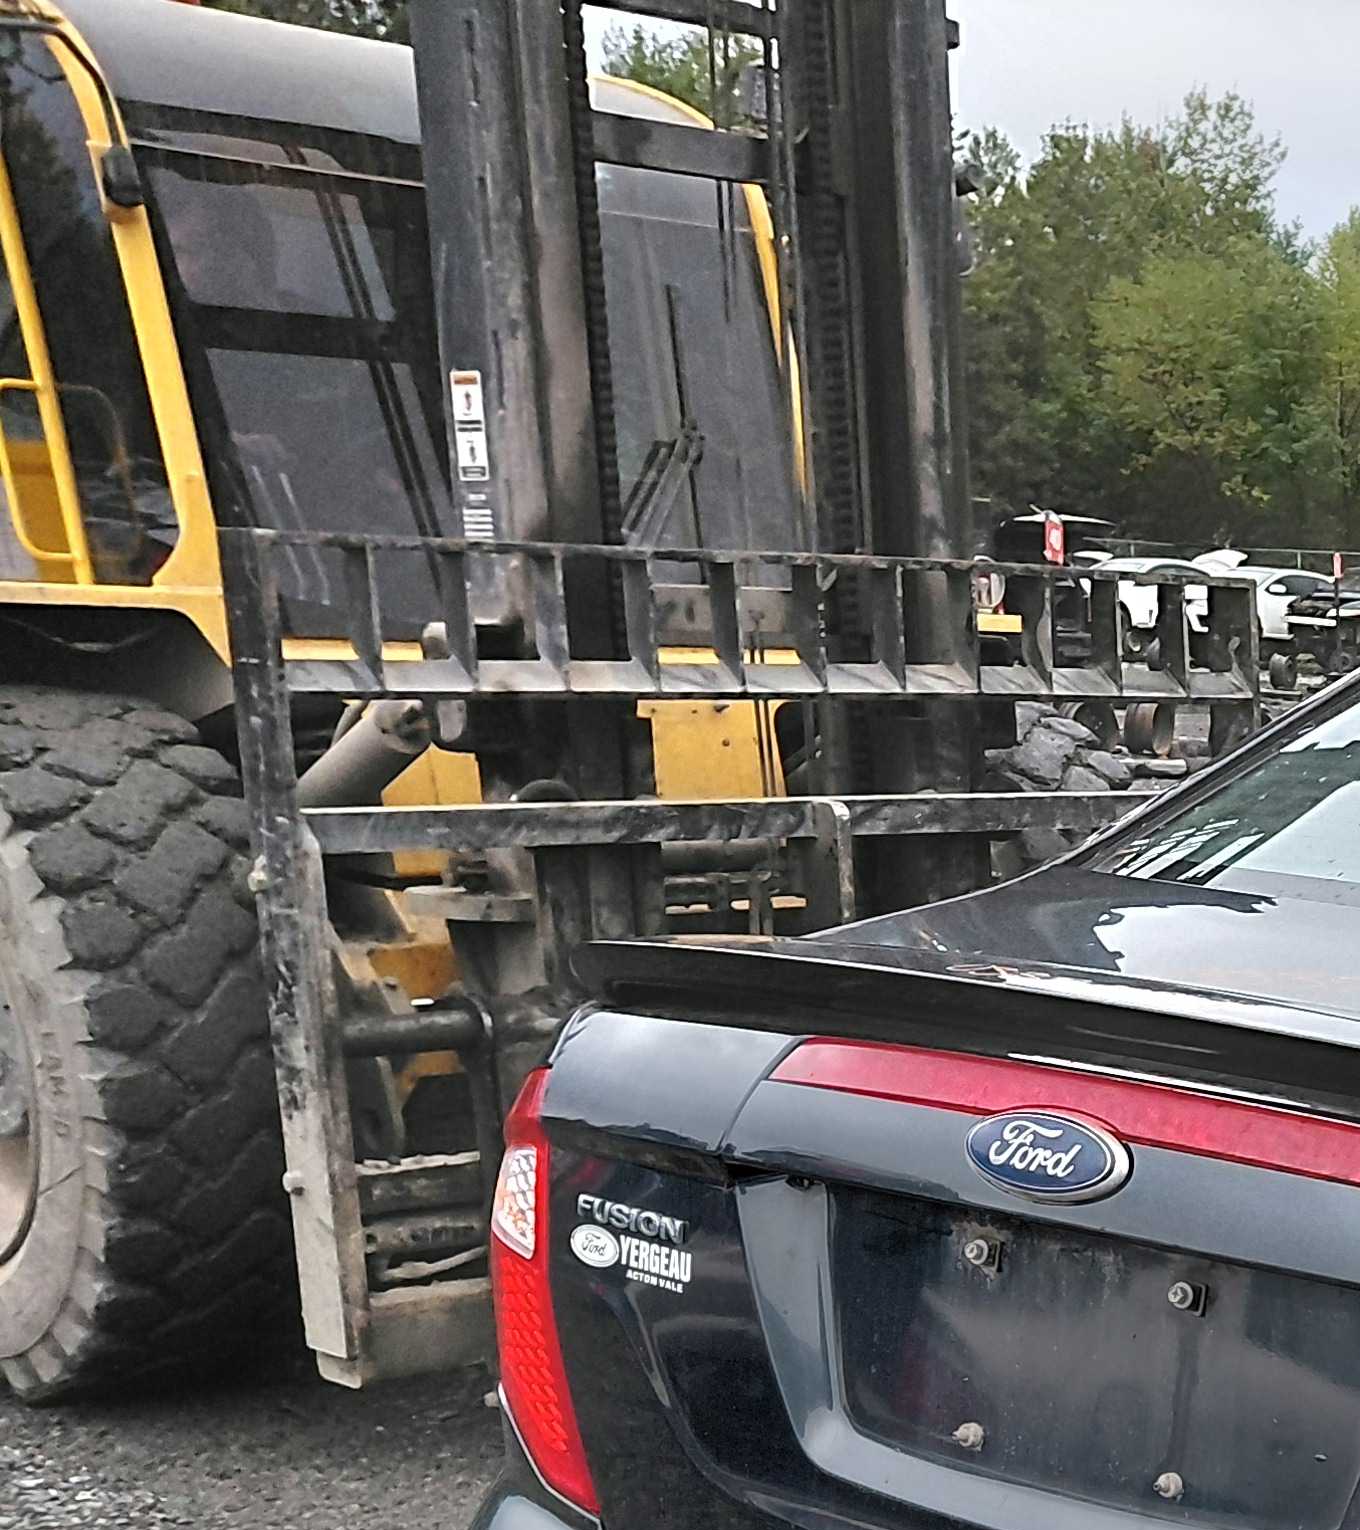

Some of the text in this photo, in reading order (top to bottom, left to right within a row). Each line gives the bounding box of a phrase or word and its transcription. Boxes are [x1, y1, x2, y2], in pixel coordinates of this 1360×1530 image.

[988, 1120, 1082, 1178] Ford
[577, 1193, 689, 1245] FUSION
[581, 1232, 608, 1257] Ford
[619, 1234, 692, 1283] YERGEAU
[625, 1268, 684, 1294] ACTON VALE
